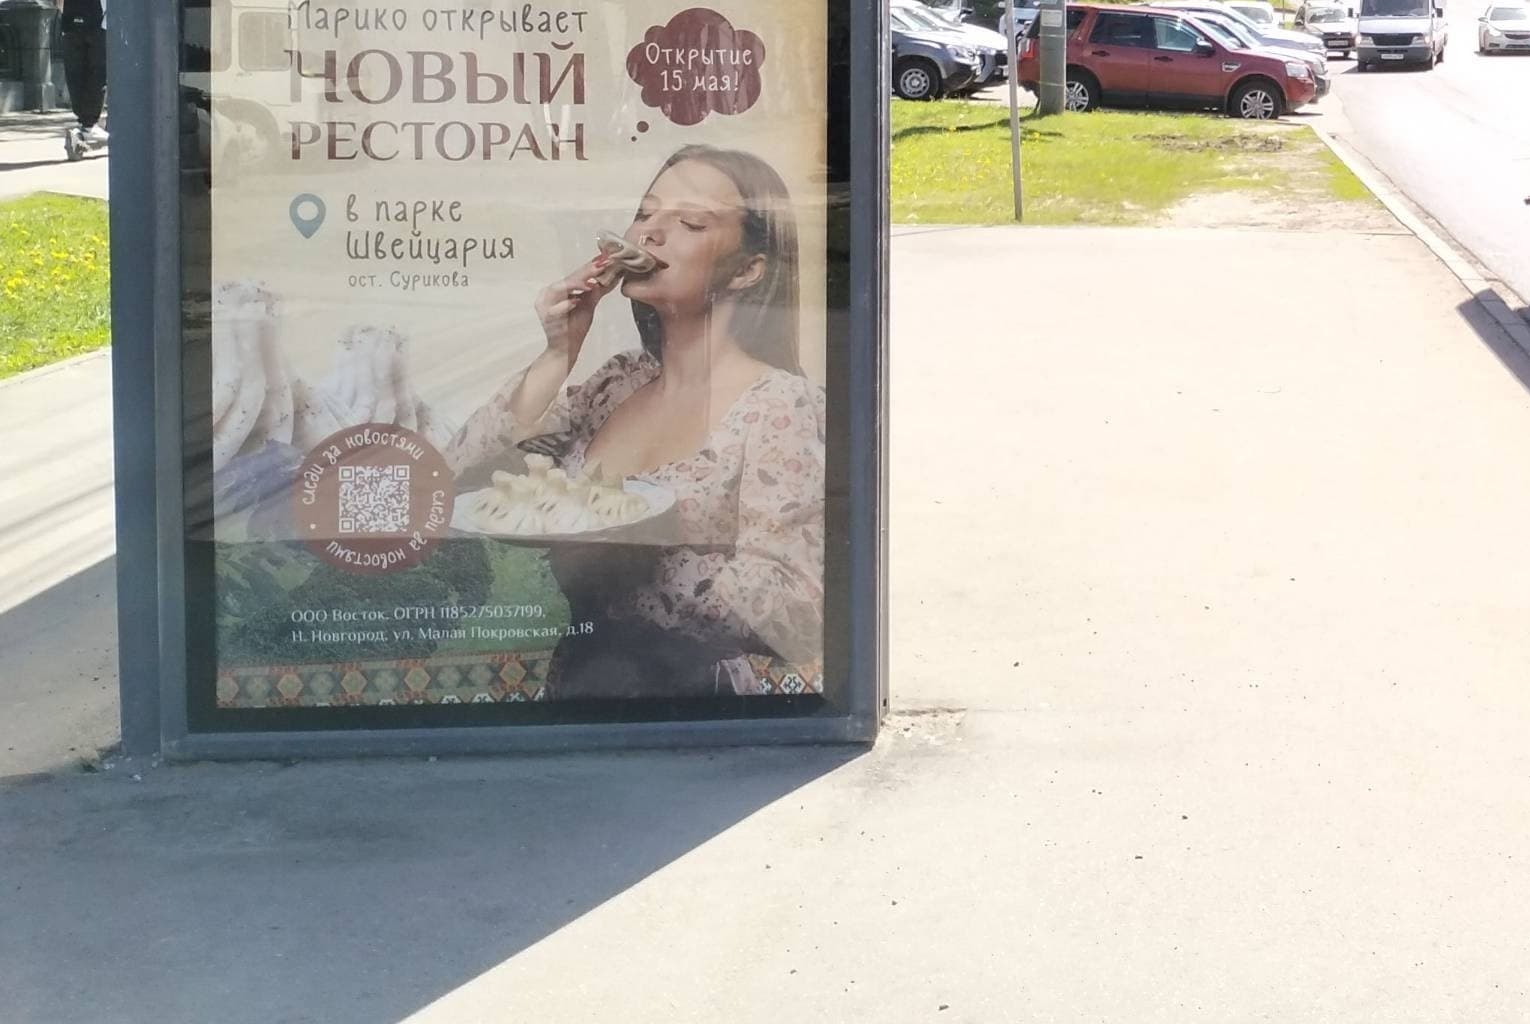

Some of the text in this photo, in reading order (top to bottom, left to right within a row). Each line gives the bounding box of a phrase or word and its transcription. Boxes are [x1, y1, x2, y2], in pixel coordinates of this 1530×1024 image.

[287, 0, 589, 41] Марико открывает
[283, 41, 586, 105] НОВЫЙ
[645, 42, 753, 71] Открытие
[660, 70, 739, 92] 15 мая!
[288, 120, 590, 161] РЕСТОРАН
[346, 193, 463, 230] в парке
[346, 229, 516, 268] Швейцария
[348, 270, 470, 291] ост. Сурикова
[322, 444, 343, 465] за
[345, 428, 425, 461] новостями
[326, 540, 407, 569] новостями
[291, 608, 328, 623] ООО
[393, 606, 436, 621] ОГРН
[419, 627, 466, 641] Малая
